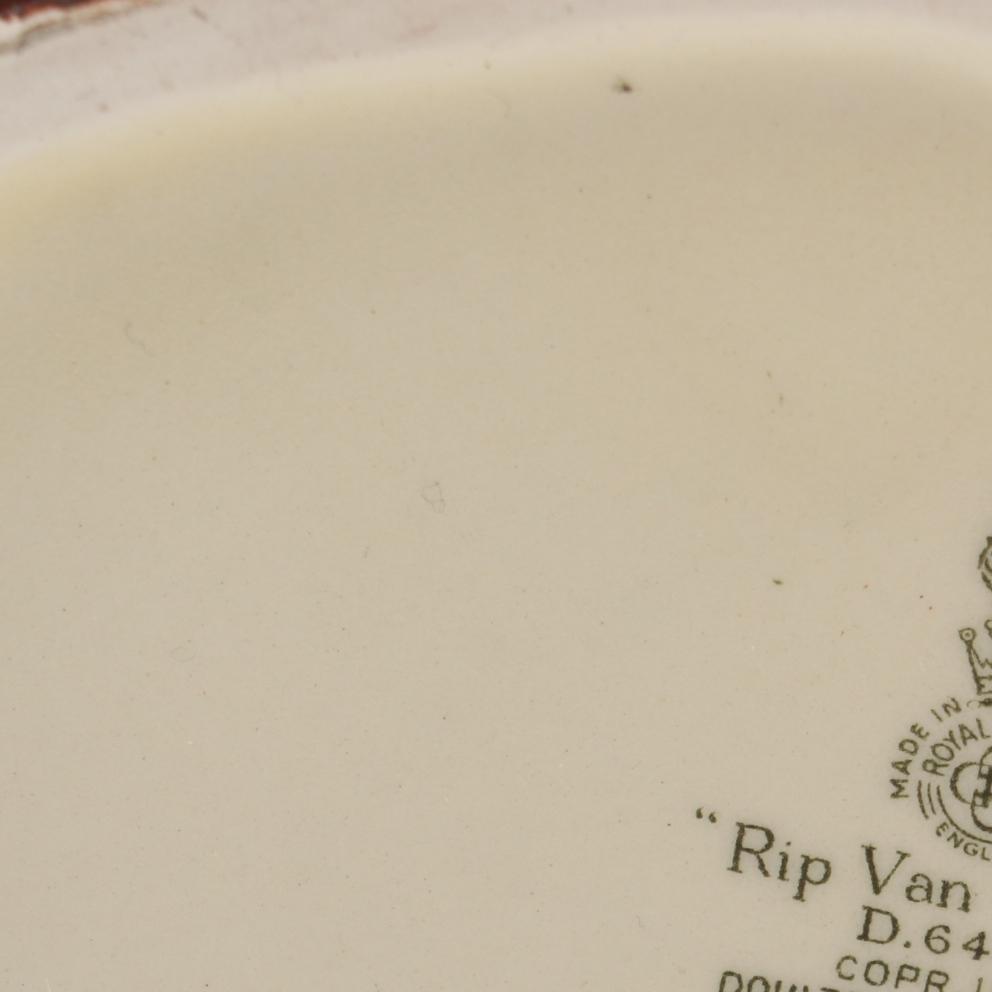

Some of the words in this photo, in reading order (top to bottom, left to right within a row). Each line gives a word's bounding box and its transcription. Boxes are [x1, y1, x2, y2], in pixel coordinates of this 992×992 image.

[890, 722, 931, 799] MADE
[930, 697, 963, 723] IN
[922, 718, 991, 777] ROYAL
[860, 844, 972, 913] Van
